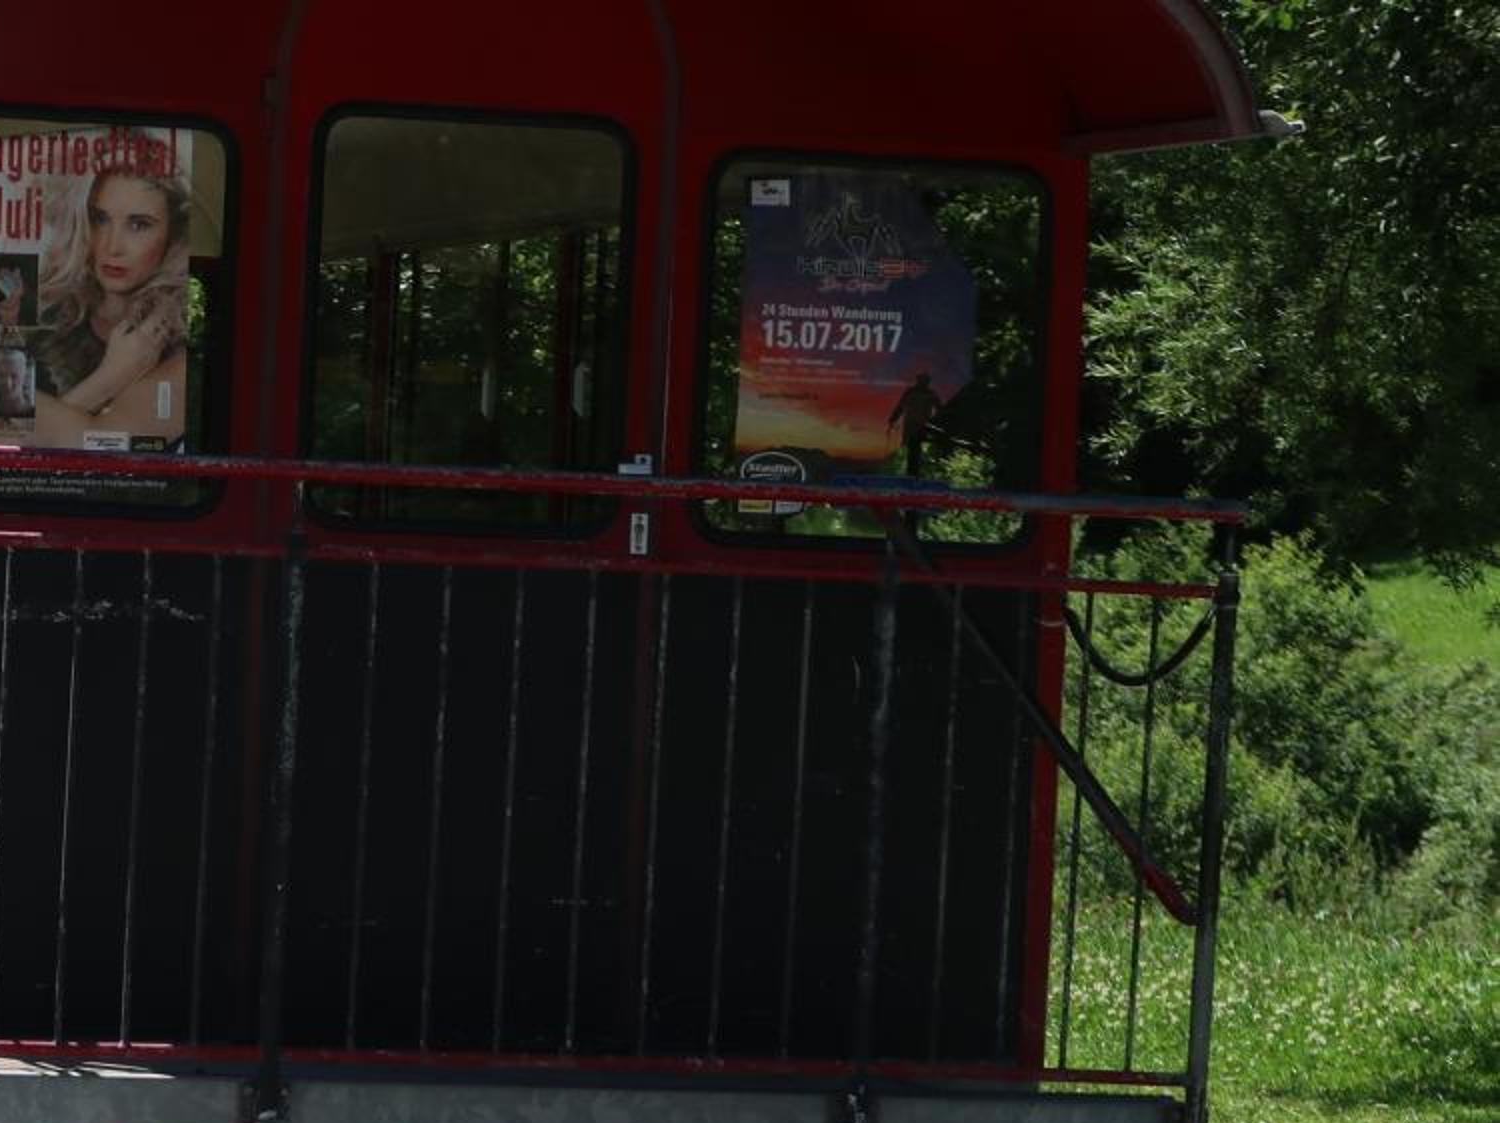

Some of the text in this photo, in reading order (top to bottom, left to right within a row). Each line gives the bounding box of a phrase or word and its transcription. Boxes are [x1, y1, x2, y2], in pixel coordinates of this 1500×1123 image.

[761, 303, 903, 323] 24 Stunden Wanderung
[760, 320, 903, 353] 15.07.2017
